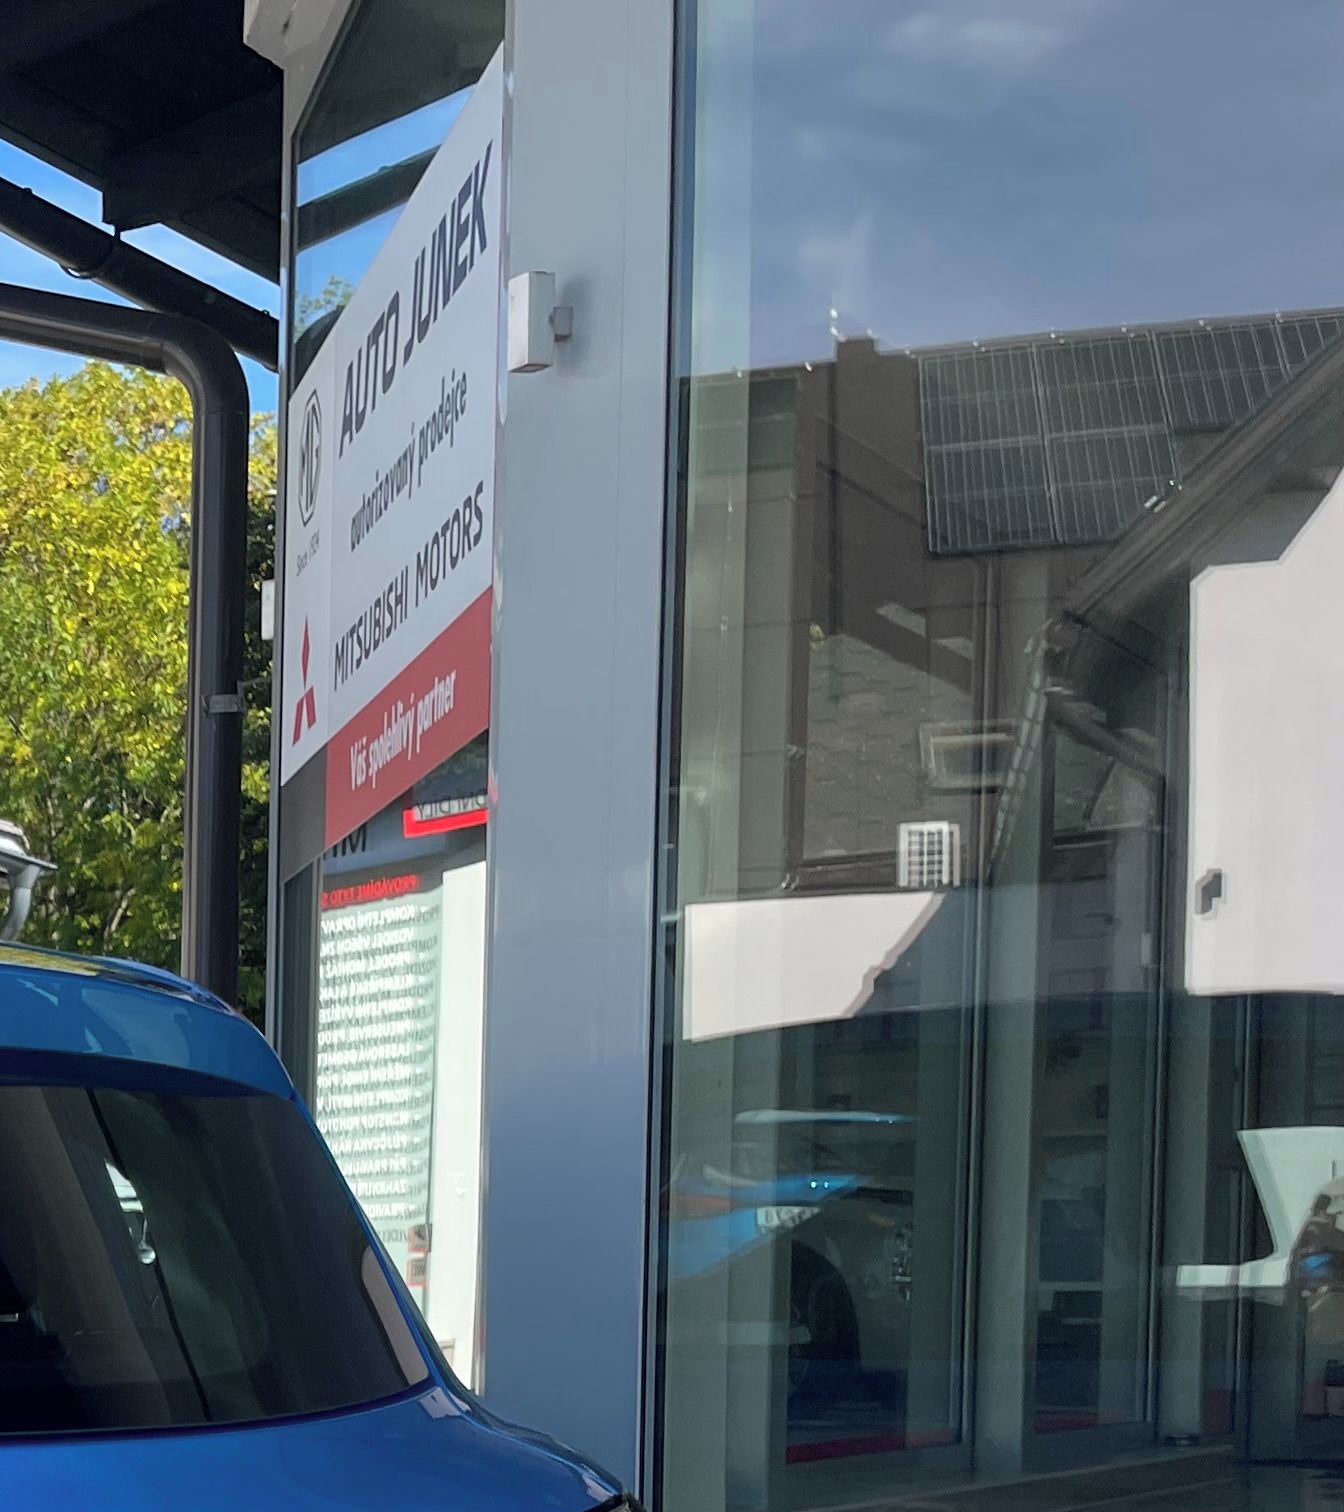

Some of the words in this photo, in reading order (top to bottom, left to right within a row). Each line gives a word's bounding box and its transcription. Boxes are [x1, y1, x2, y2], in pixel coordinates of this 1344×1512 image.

[339, 291, 399, 459] AUTO
[403, 139, 493, 368] JUNEK
[350, 422, 416, 552] autorizovaný
[418, 368, 468, 488] prodejce
[334, 564, 409, 692] MITSUBISHI
[415, 480, 484, 608] MOTORS
[349, 735, 368, 791] Váš
[368, 692, 415, 789] spolehlivý
[417, 670, 457, 754] partner
